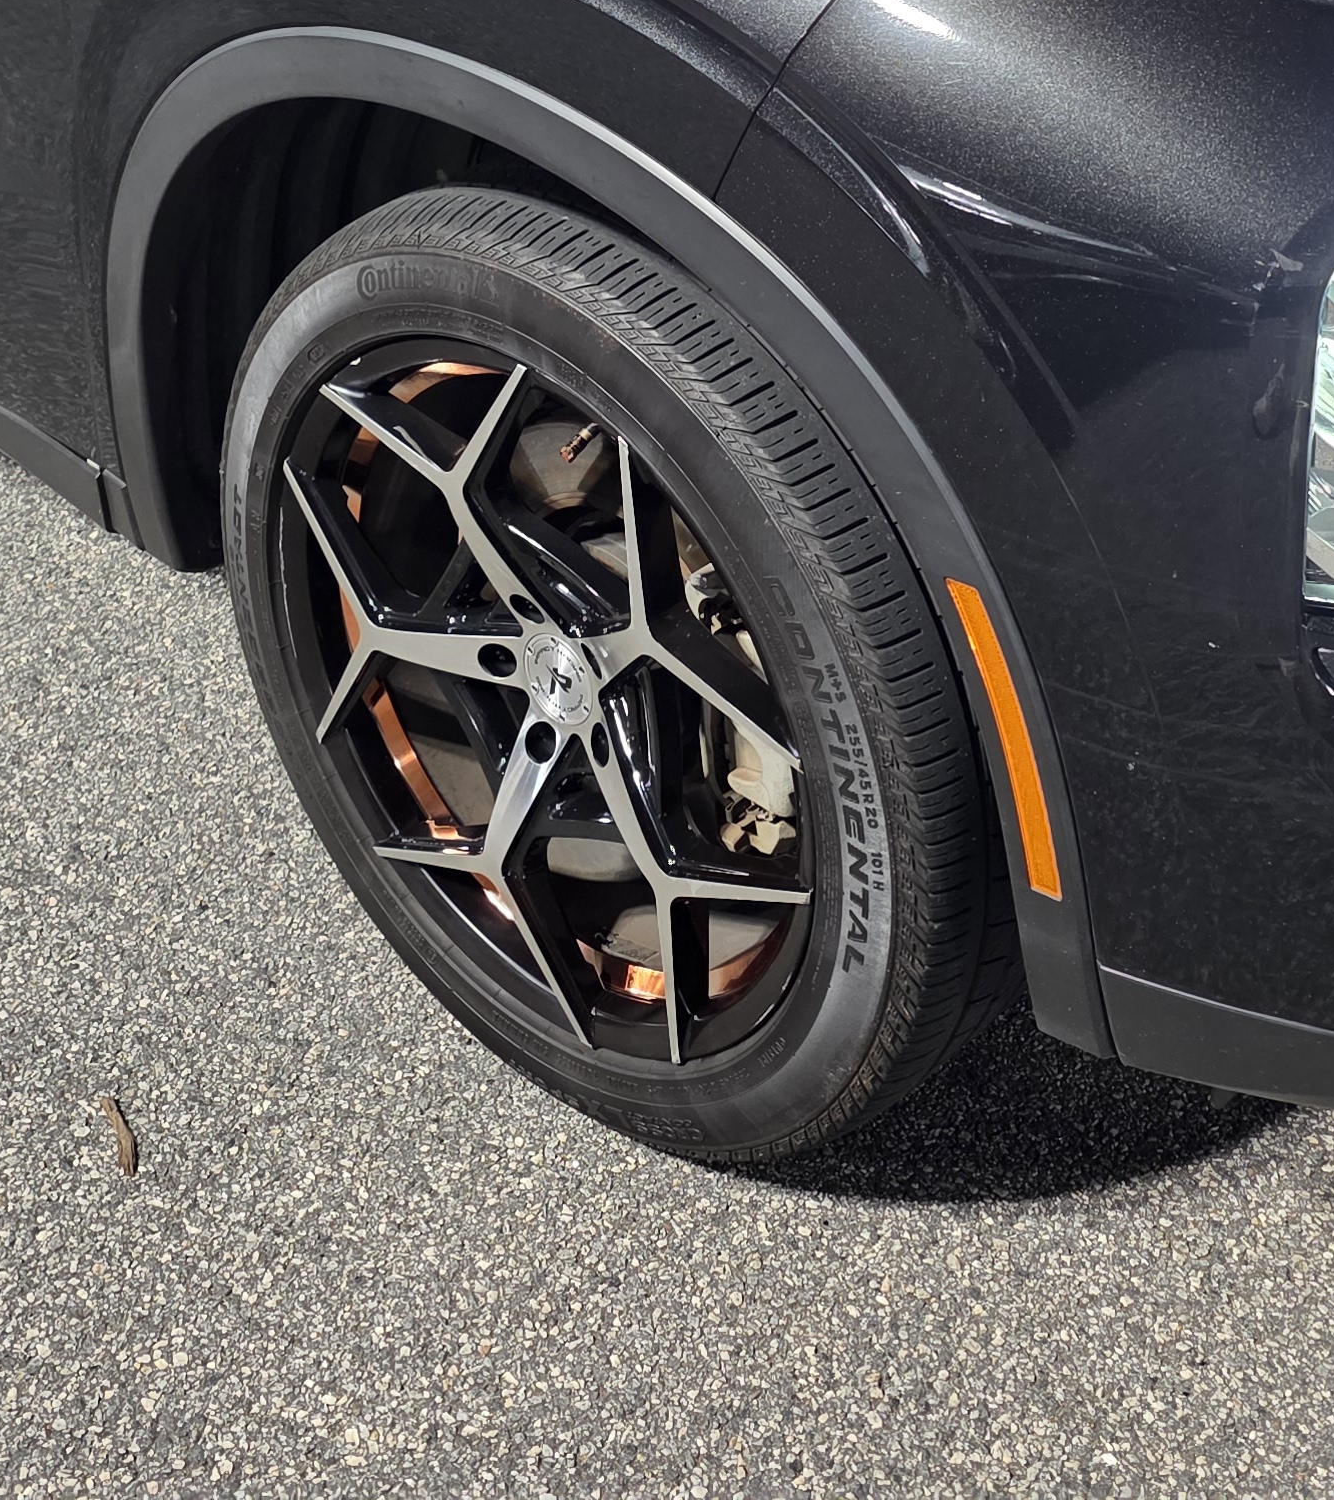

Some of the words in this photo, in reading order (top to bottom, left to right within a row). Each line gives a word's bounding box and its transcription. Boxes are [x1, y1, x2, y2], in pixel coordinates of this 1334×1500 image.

[356, 260, 480, 302] Continental
[823, 662, 847, 704] M+S
[764, 575, 870, 974] CONTINENTAL
